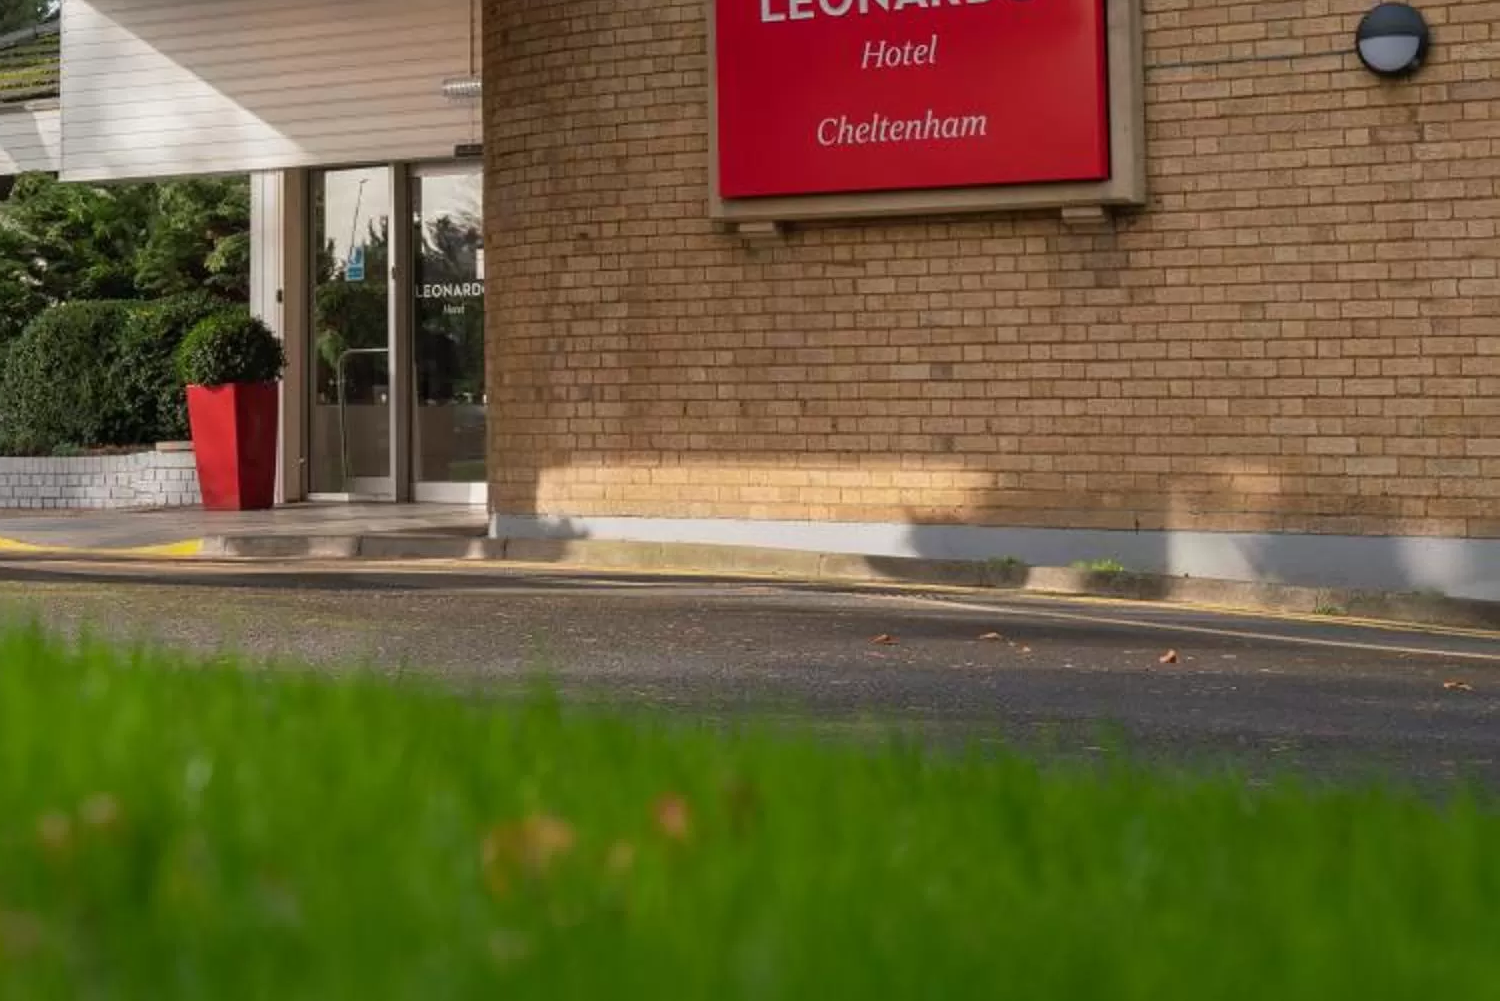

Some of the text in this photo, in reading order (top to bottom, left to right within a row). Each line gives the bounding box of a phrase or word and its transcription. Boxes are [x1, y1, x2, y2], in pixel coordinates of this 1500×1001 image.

[861, 35, 937, 69] Hotel
[817, 109, 987, 146] Cheltenham
[415, 282, 485, 298] LEONARD
